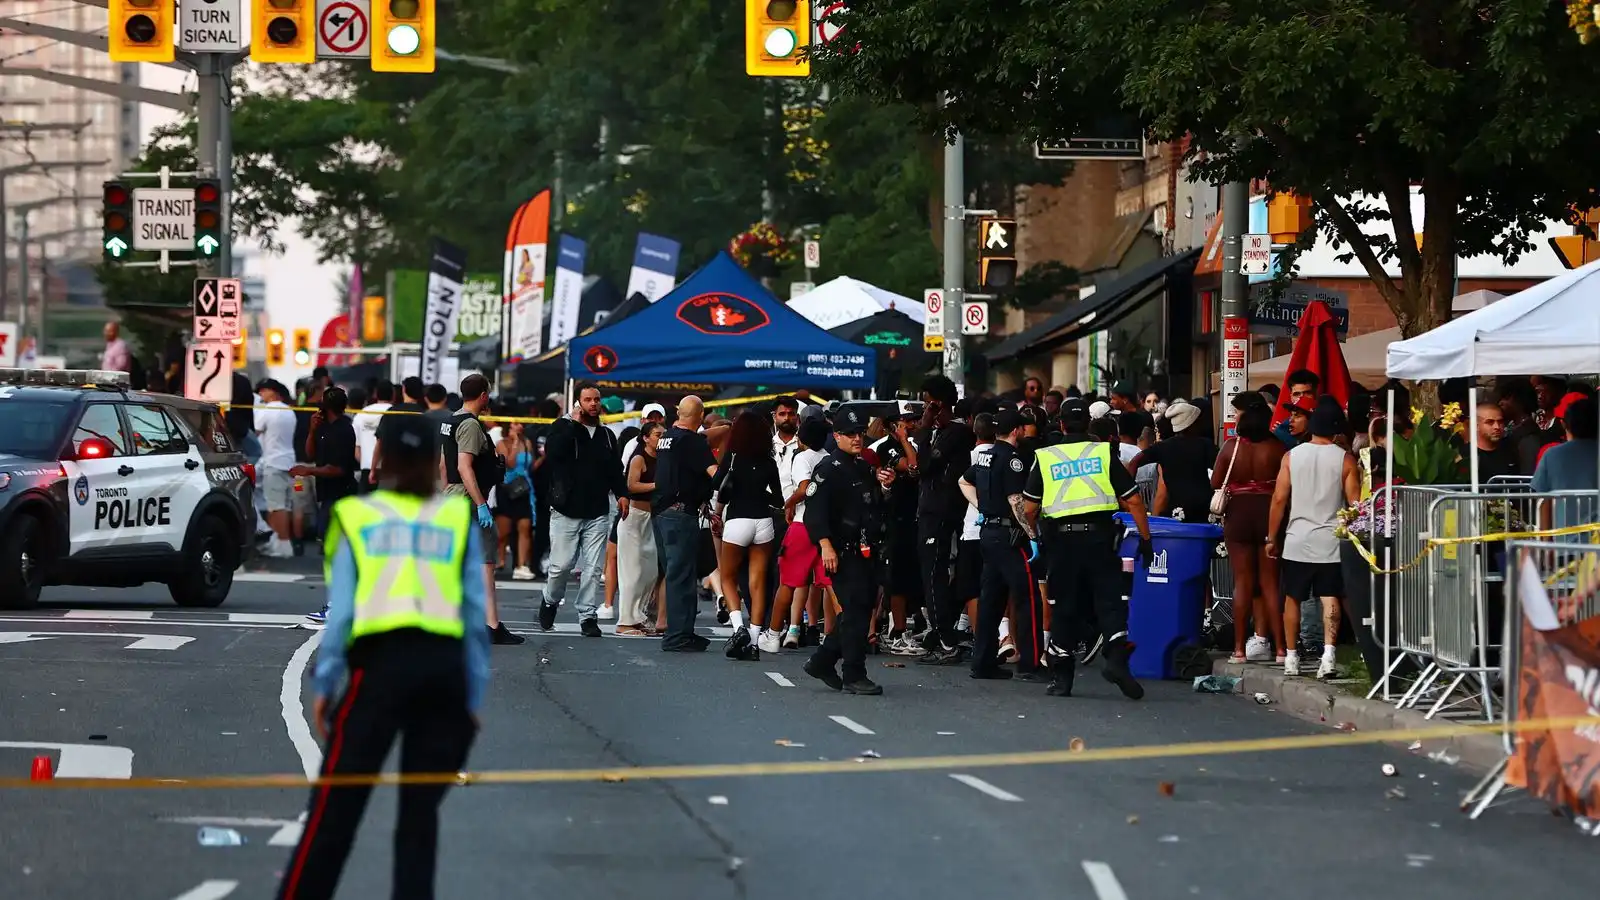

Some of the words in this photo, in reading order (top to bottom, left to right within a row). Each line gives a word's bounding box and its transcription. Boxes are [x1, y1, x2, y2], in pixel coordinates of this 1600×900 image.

[192, 9, 230, 23] TURN
[184, 29, 237, 43] SIGNAL
[138, 199, 192, 216] TRANSIT
[142, 223, 189, 240] SIGNAL
[1251, 238, 1262, 248] NO
[1243, 250, 1269, 261] STANDING
[745, 360, 772, 369] ONSITE
[774, 361, 798, 369] MEDIC
[807, 366, 864, 378] canaphem.ca
[210, 466, 240, 481] PSRT17
[1052, 458, 1101, 479] POLICE
[95, 487, 128, 499] TORONTO
[94, 496, 171, 530] POLICE
